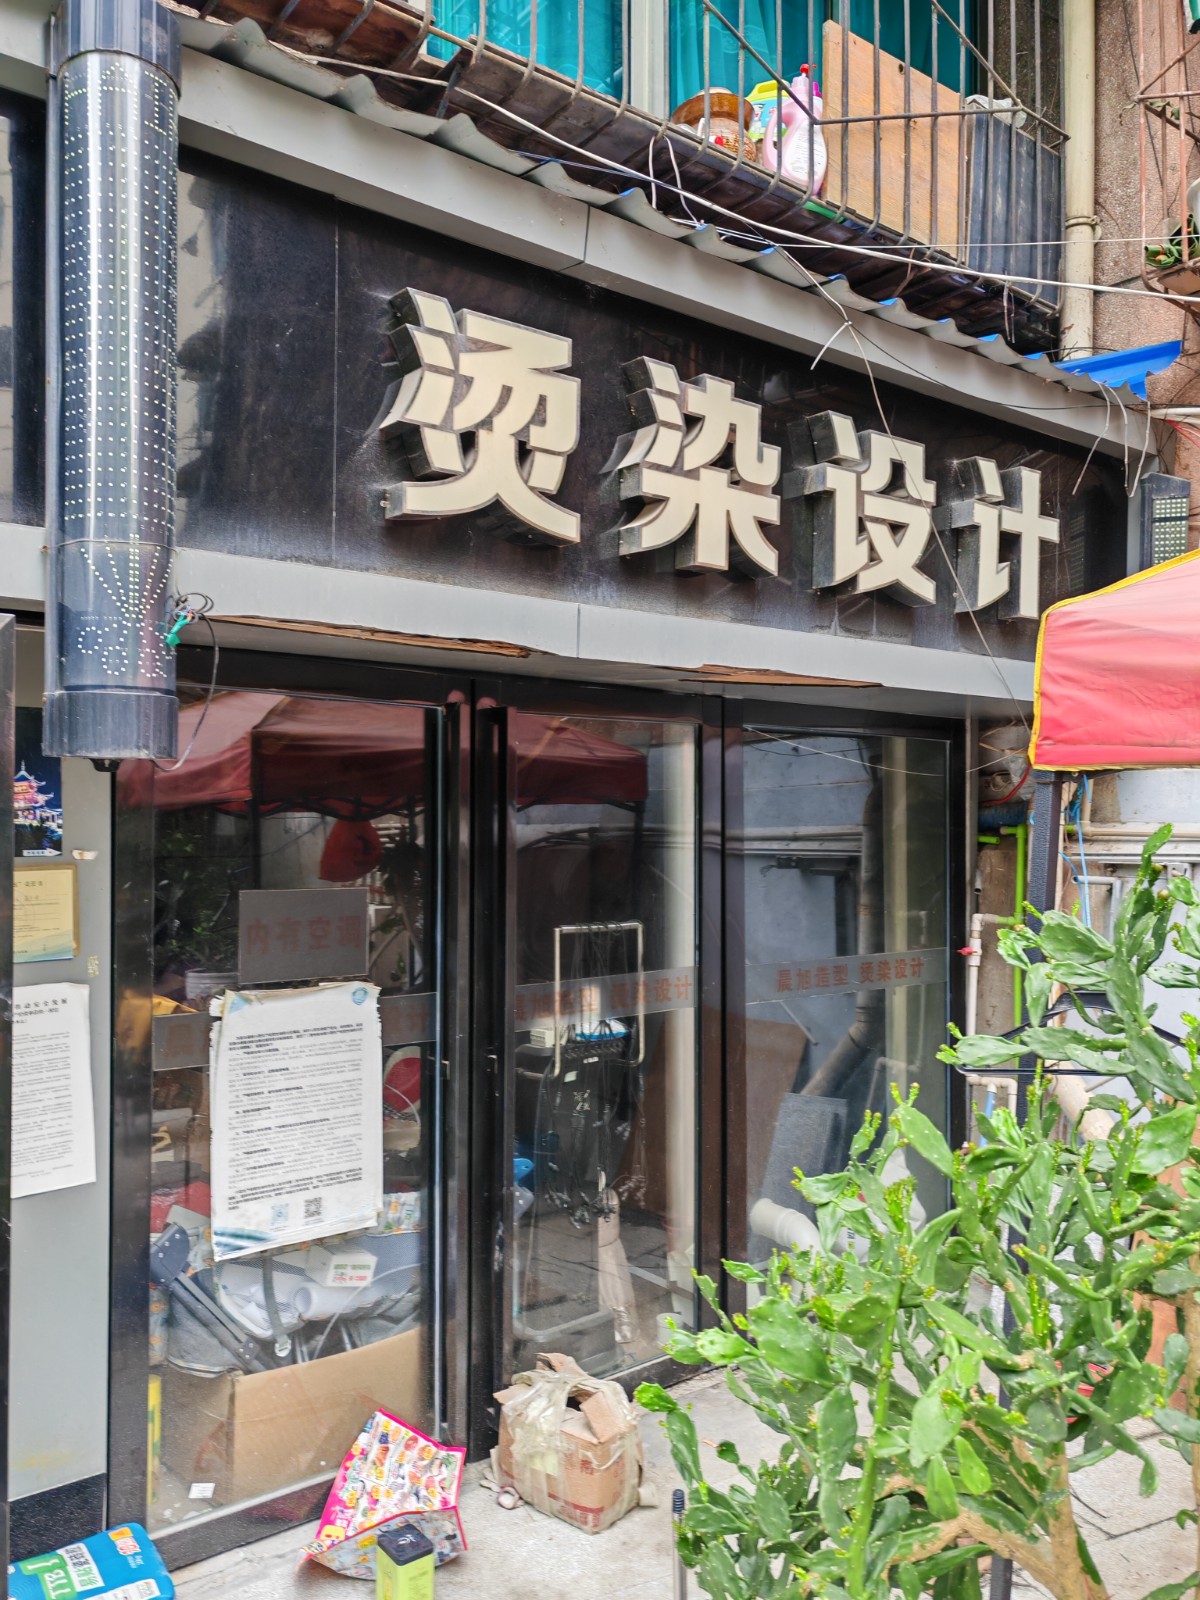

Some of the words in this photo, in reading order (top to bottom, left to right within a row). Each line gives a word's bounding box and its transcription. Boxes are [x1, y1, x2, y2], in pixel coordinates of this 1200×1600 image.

[380, 287, 1060, 621] 烫染设计
[246, 915, 363, 955] 内有空调
[776, 964, 849, 993] 晨旭造型
[859, 957, 925, 984] 烫染设计
